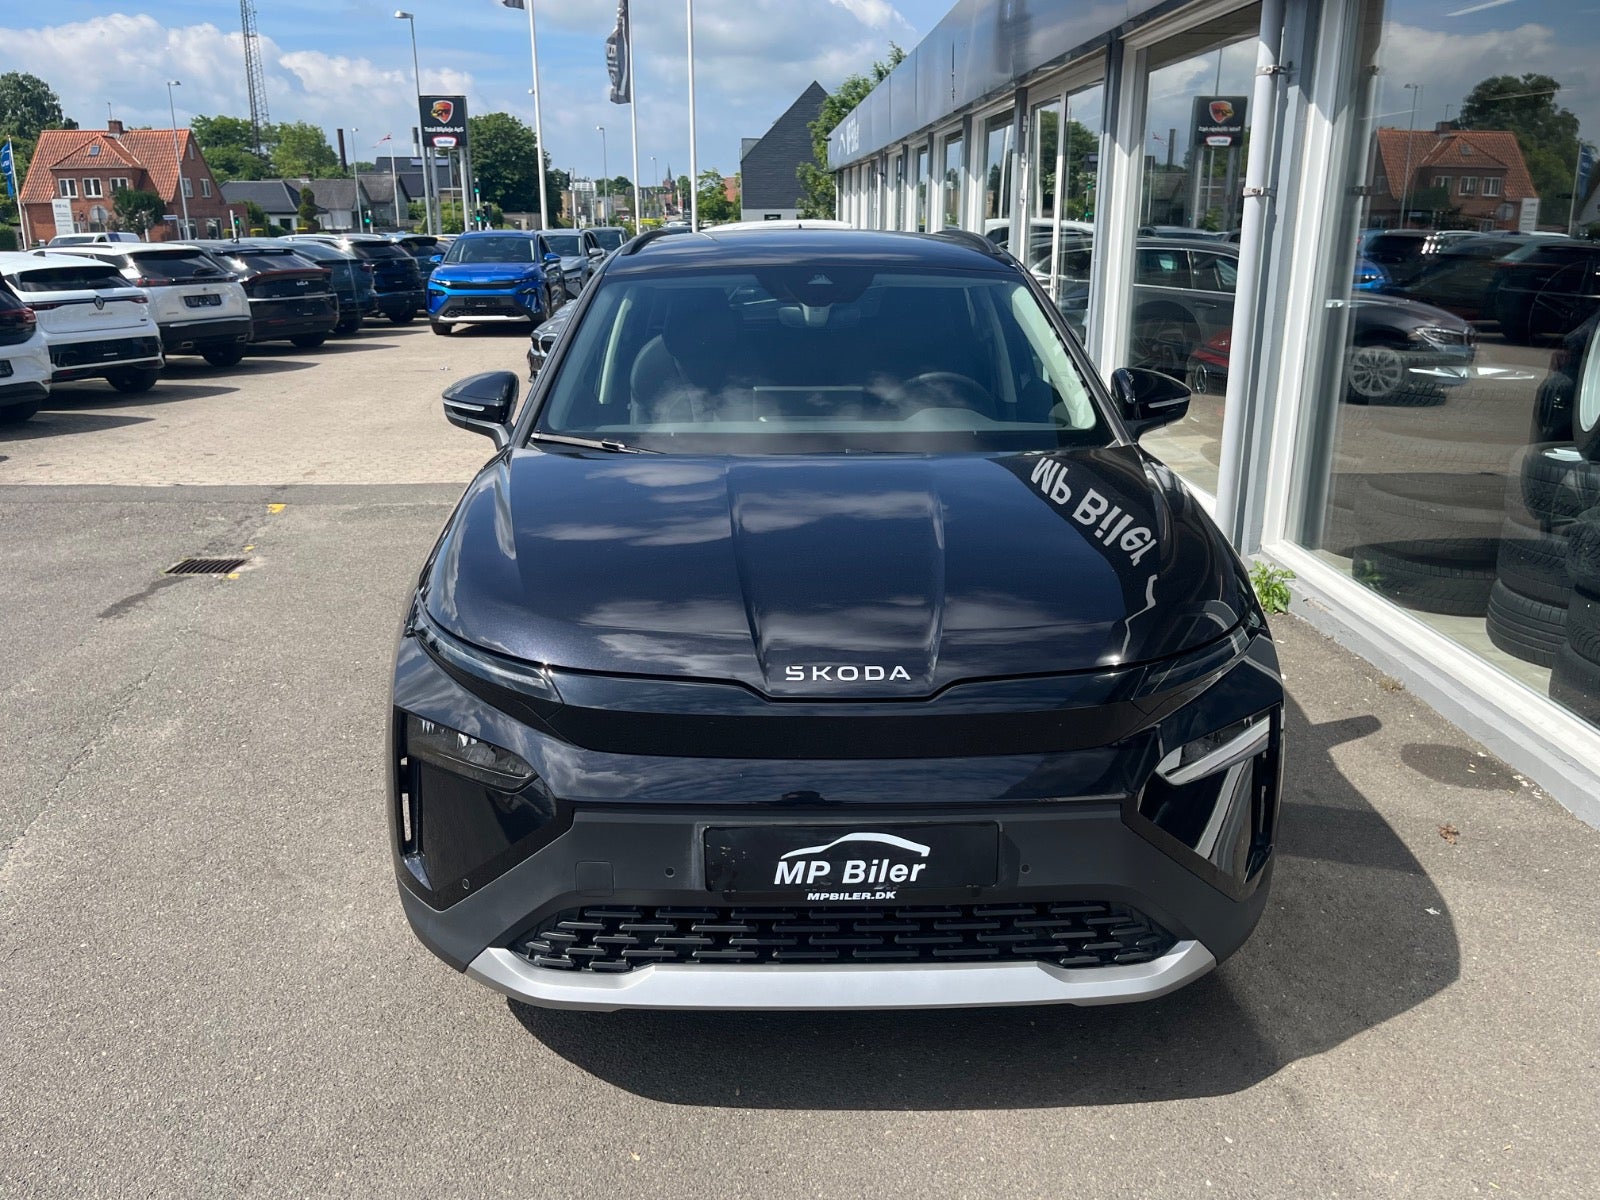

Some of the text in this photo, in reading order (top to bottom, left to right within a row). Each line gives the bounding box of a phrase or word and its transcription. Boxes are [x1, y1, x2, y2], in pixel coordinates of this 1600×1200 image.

[774, 858, 926, 885] MP Biler
[807, 891, 897, 901] MPBILER.DK
